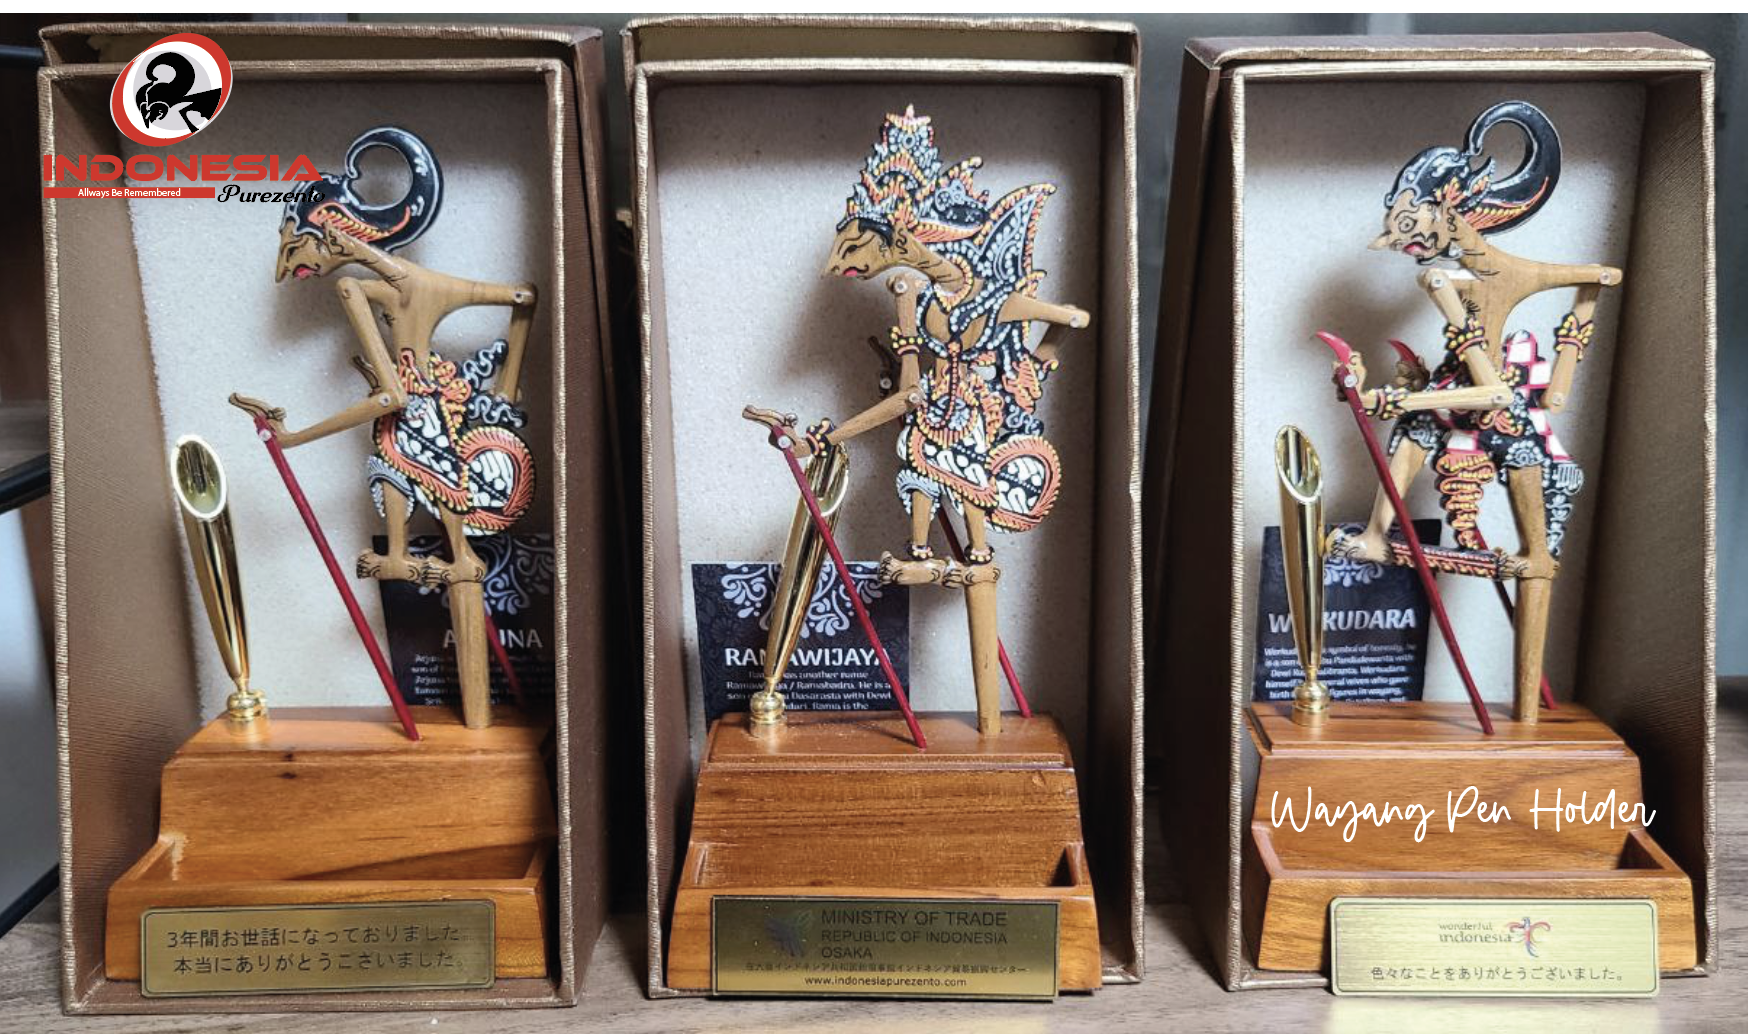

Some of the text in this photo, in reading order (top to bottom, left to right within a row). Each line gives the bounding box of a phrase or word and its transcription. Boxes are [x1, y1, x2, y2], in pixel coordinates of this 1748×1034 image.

[1269, 608, 1416, 633] WKUDARA
[859, 681, 872, 689] He
[843, 691, 865, 699] with
[821, 910, 1007, 926] MINISTRY OF TRADE
[821, 930, 1007, 944] REPUBLIC OF INDONESIA
[1439, 931, 1513, 943] indonesia
[821, 947, 873, 959] OSAKA
[804, 976, 967, 987] www.indonesiapurezento.com
